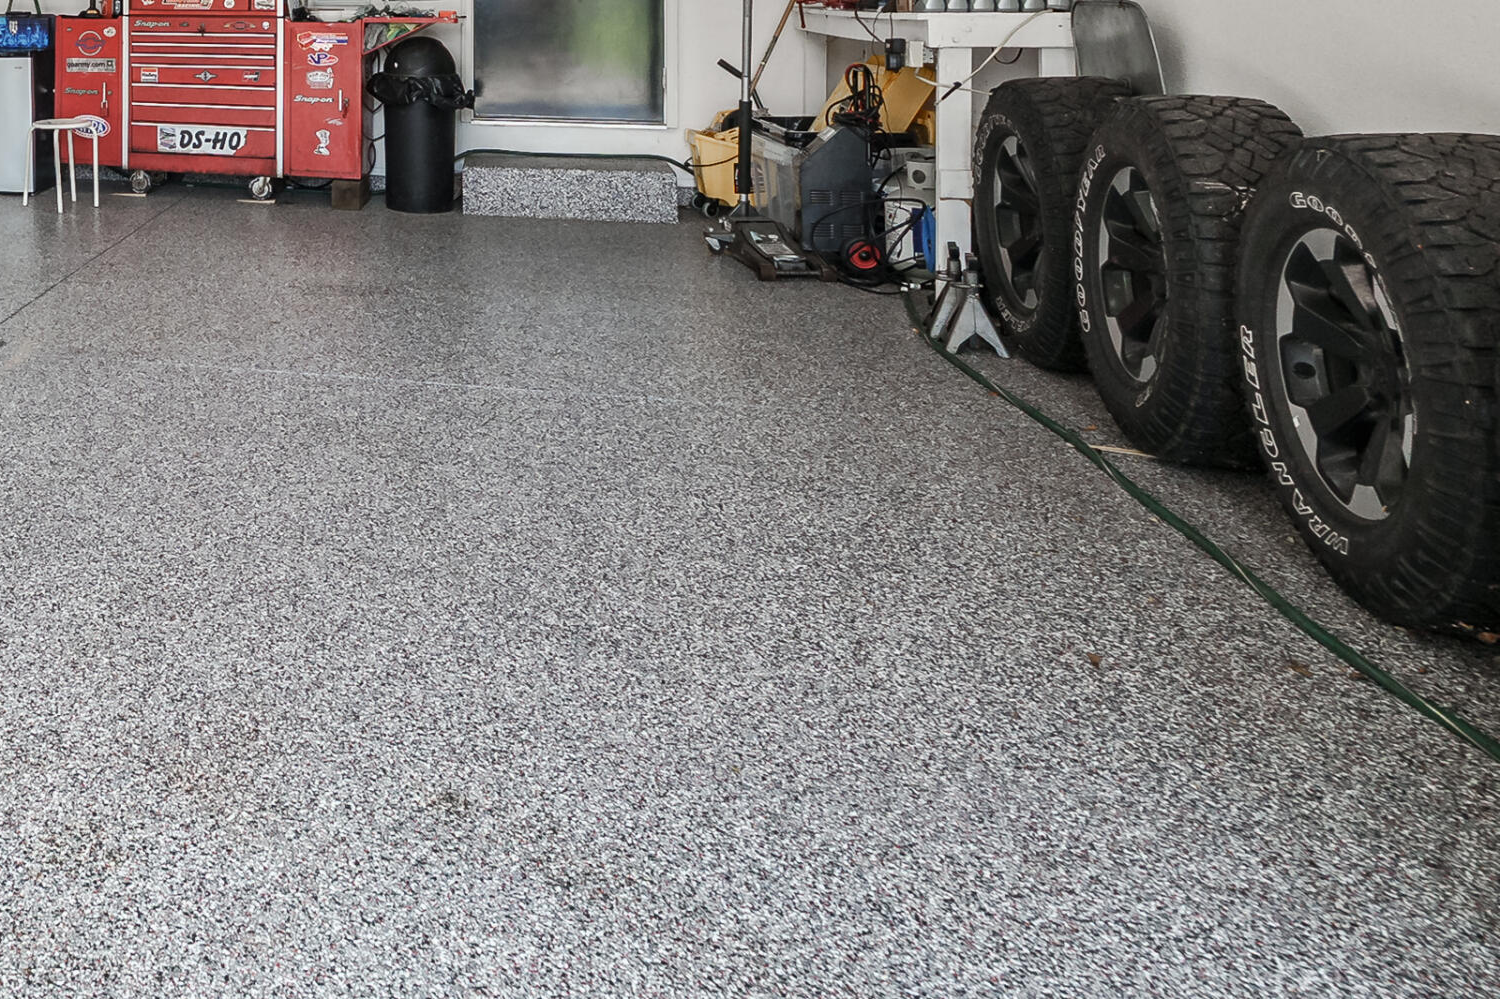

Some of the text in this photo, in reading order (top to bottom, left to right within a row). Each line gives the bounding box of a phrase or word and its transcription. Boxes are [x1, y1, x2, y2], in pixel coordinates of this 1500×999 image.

[134, 20, 171, 28] Snap-on
[293, 95, 334, 104] Snap-on
[180, 130, 241, 151] DS-HO
[1240, 324, 1349, 556] WRANGLER
